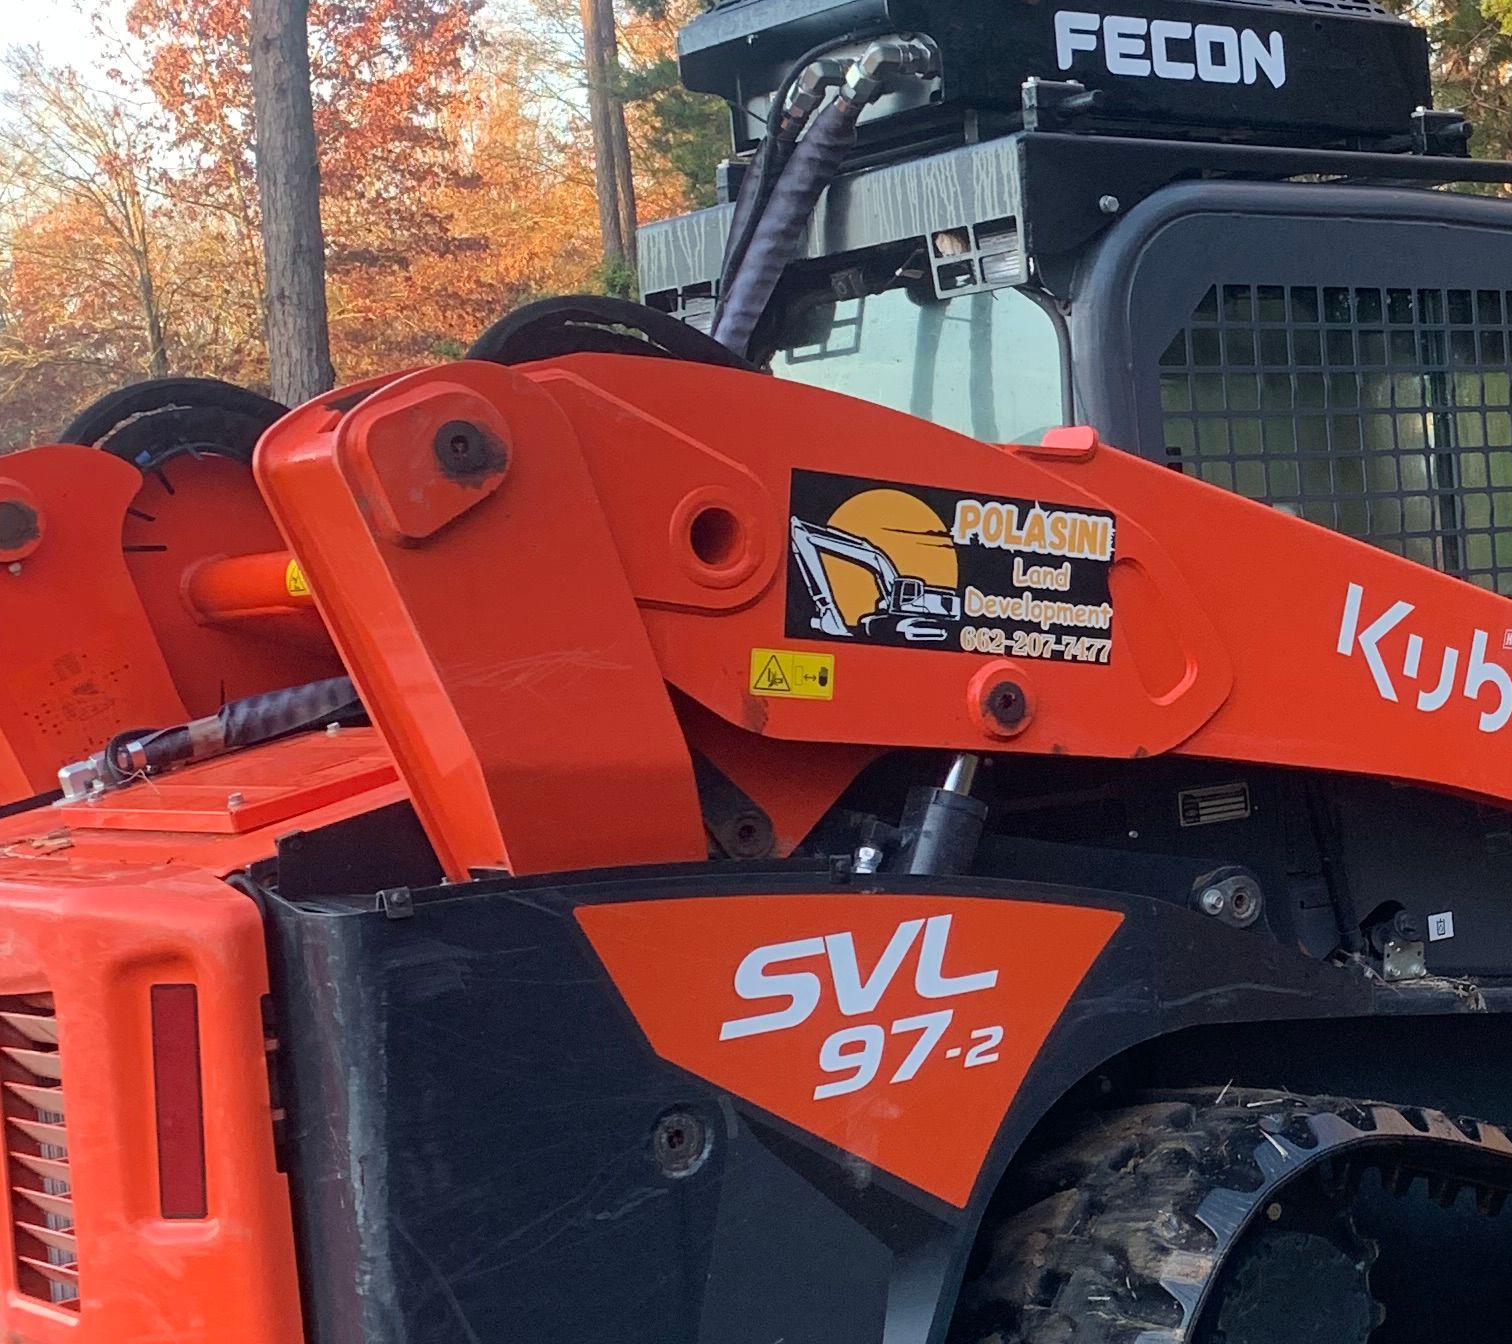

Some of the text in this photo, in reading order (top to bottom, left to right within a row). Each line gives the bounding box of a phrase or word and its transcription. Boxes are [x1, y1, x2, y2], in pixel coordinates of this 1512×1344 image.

[1054, 10, 1287, 89] FECON
[954, 501, 1114, 560] POLASINI
[1012, 558, 1071, 591] Land
[964, 587, 1113, 630] Development
[960, 627, 1112, 663] 662-207-7477
[718, 913, 999, 1041] SVL
[813, 1009, 1004, 1100] 97-2
